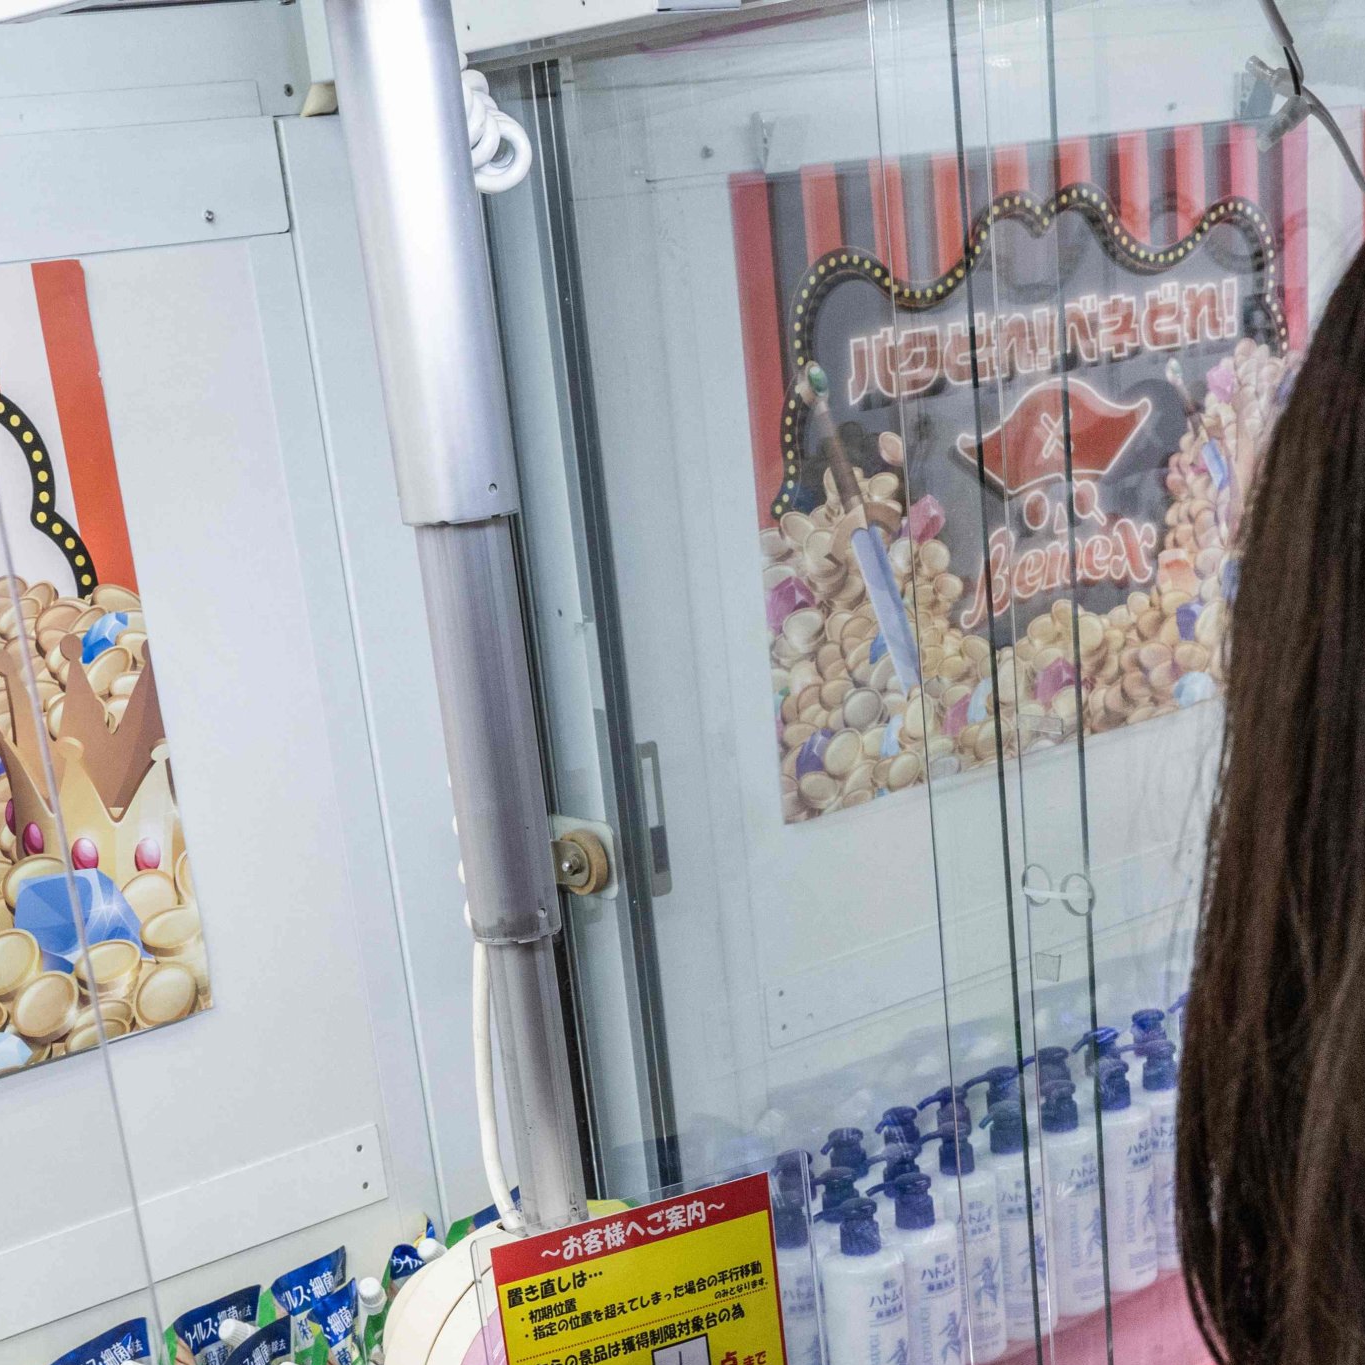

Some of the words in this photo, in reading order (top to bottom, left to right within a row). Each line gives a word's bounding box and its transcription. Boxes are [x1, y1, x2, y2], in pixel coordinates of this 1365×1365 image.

[714, 1280, 768, 1299] のみとなります。
